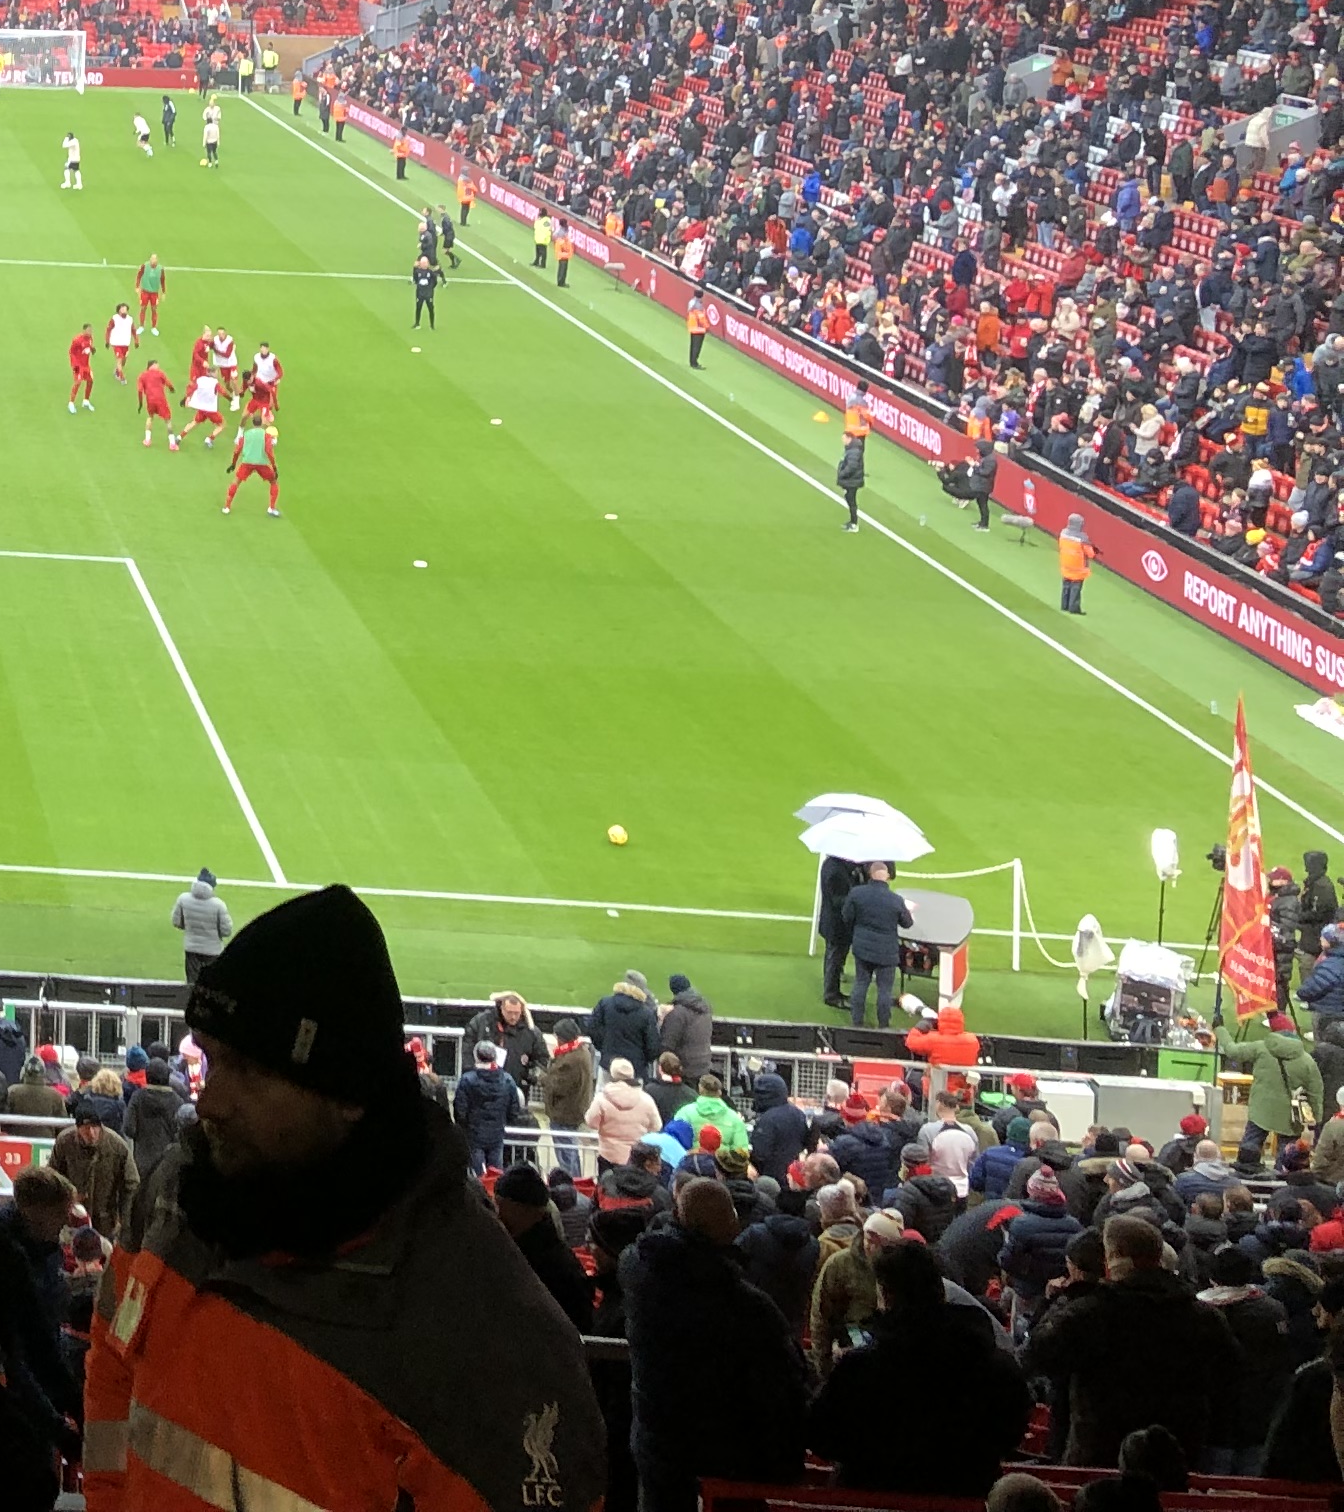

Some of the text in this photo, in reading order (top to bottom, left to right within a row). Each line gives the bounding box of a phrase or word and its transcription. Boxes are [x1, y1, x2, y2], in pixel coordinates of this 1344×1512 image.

[725, 314, 750, 345] REPORT
[750, 326, 785, 365] ANYTHING
[785, 347, 828, 391] SUSPICIOUS
[828, 371, 840, 397] TO
[865, 390, 900, 430] EAREST
[899, 412, 942, 456] STEWARD
[1184, 570, 1238, 624] REPORT
[1237, 601, 1313, 668] ANYTHING
[522, 1484, 565, 1507] LFC
